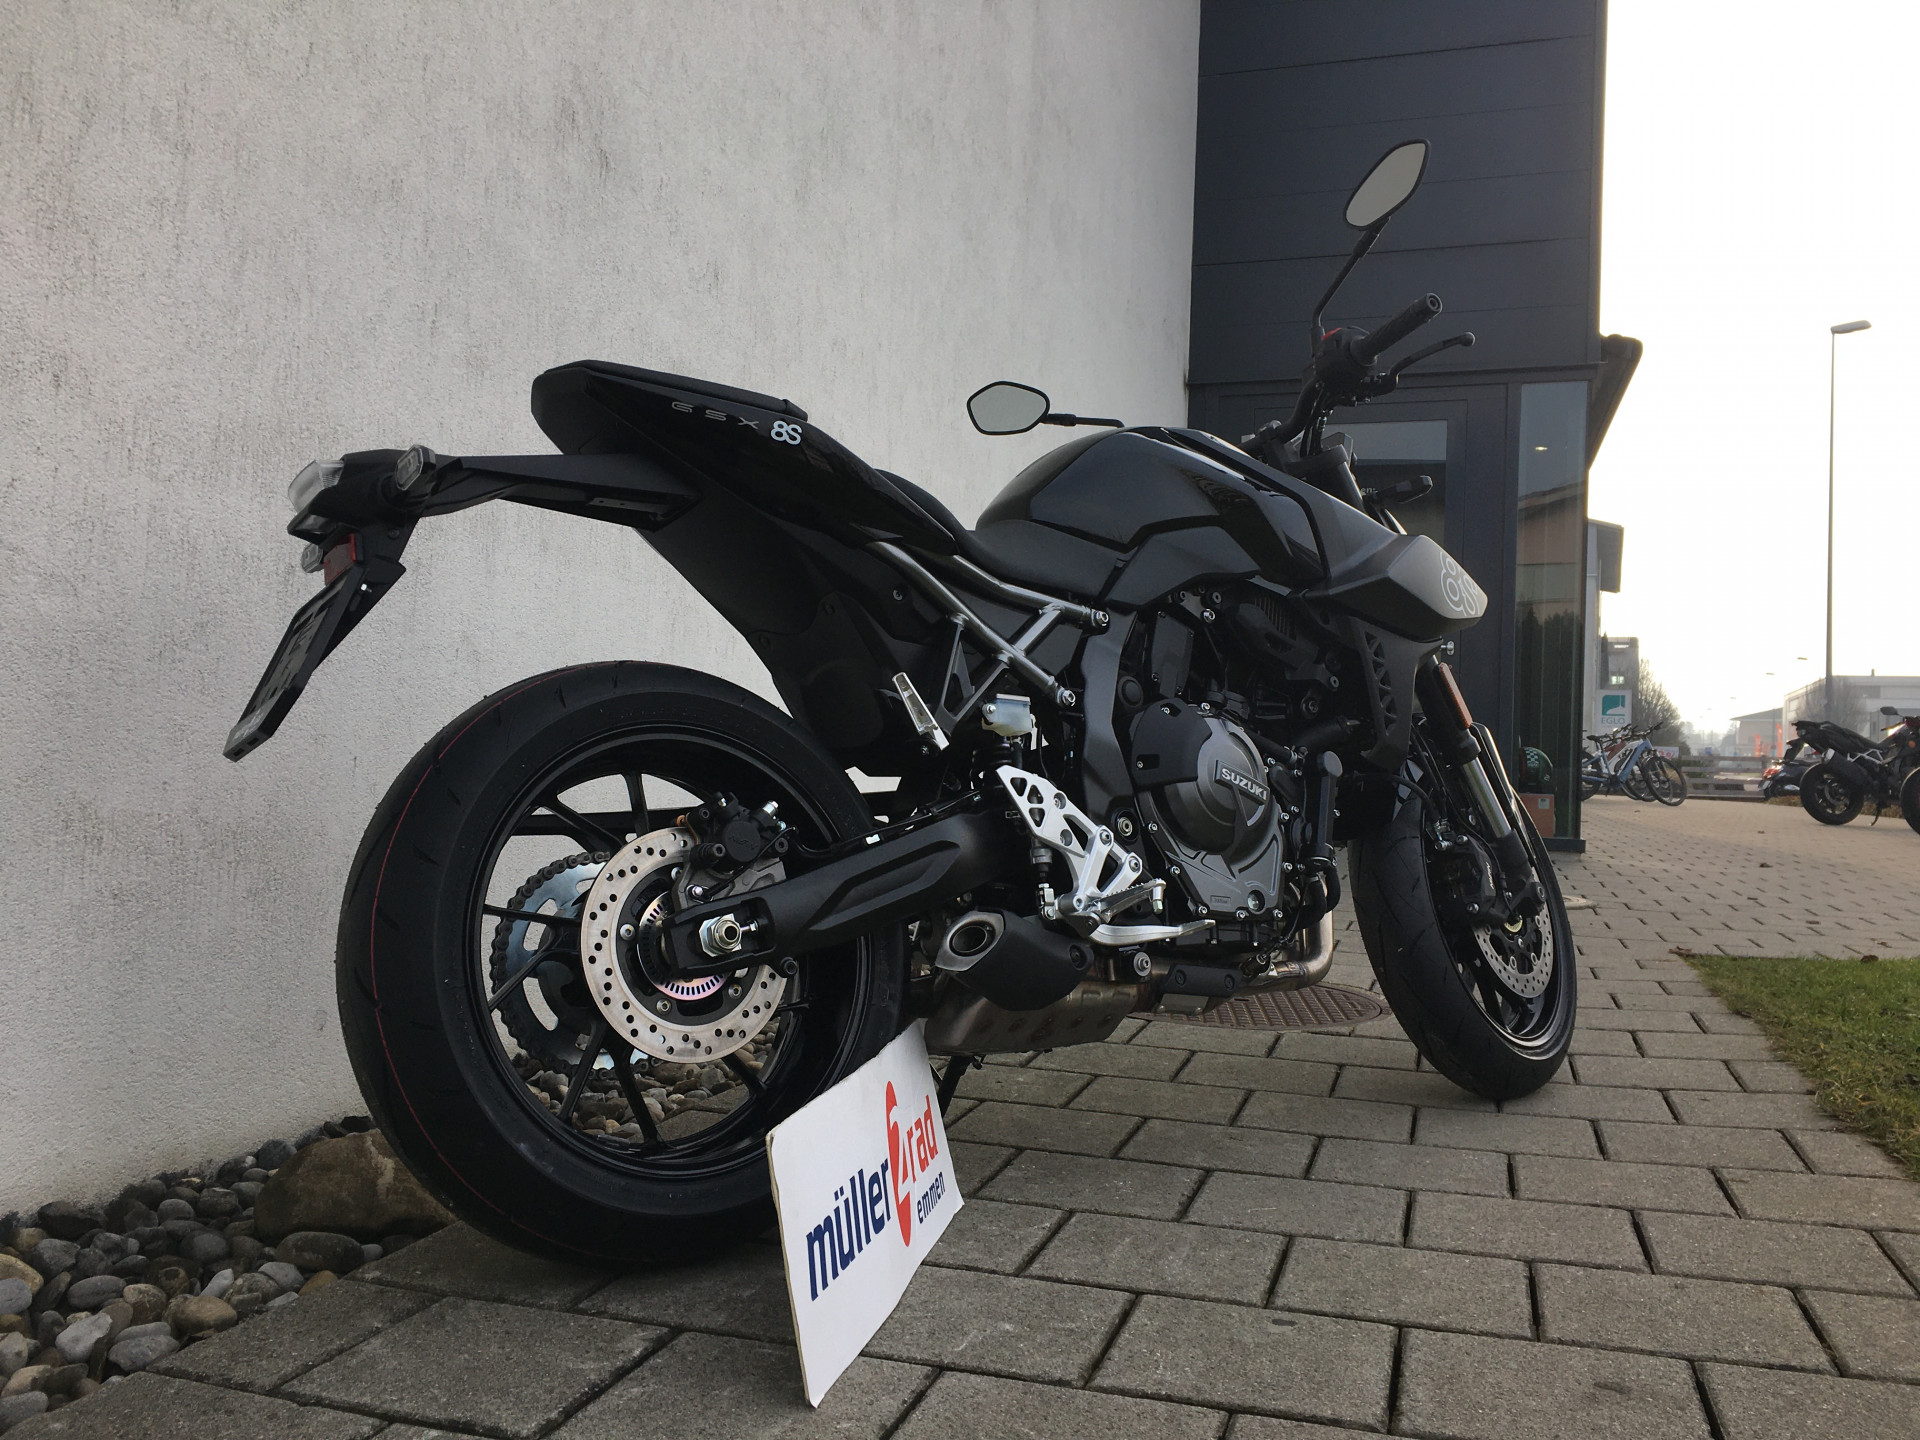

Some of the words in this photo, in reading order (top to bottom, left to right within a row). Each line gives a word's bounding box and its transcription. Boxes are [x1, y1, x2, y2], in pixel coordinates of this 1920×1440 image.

[671, 401, 759, 430] GSX
[771, 420, 803, 446] 8S
[1601, 716, 1626, 725] EGLO
[1221, 768, 1267, 801] SUZUKI
[916, 1171, 946, 1225] emmen
[806, 1158, 891, 1301] müller
